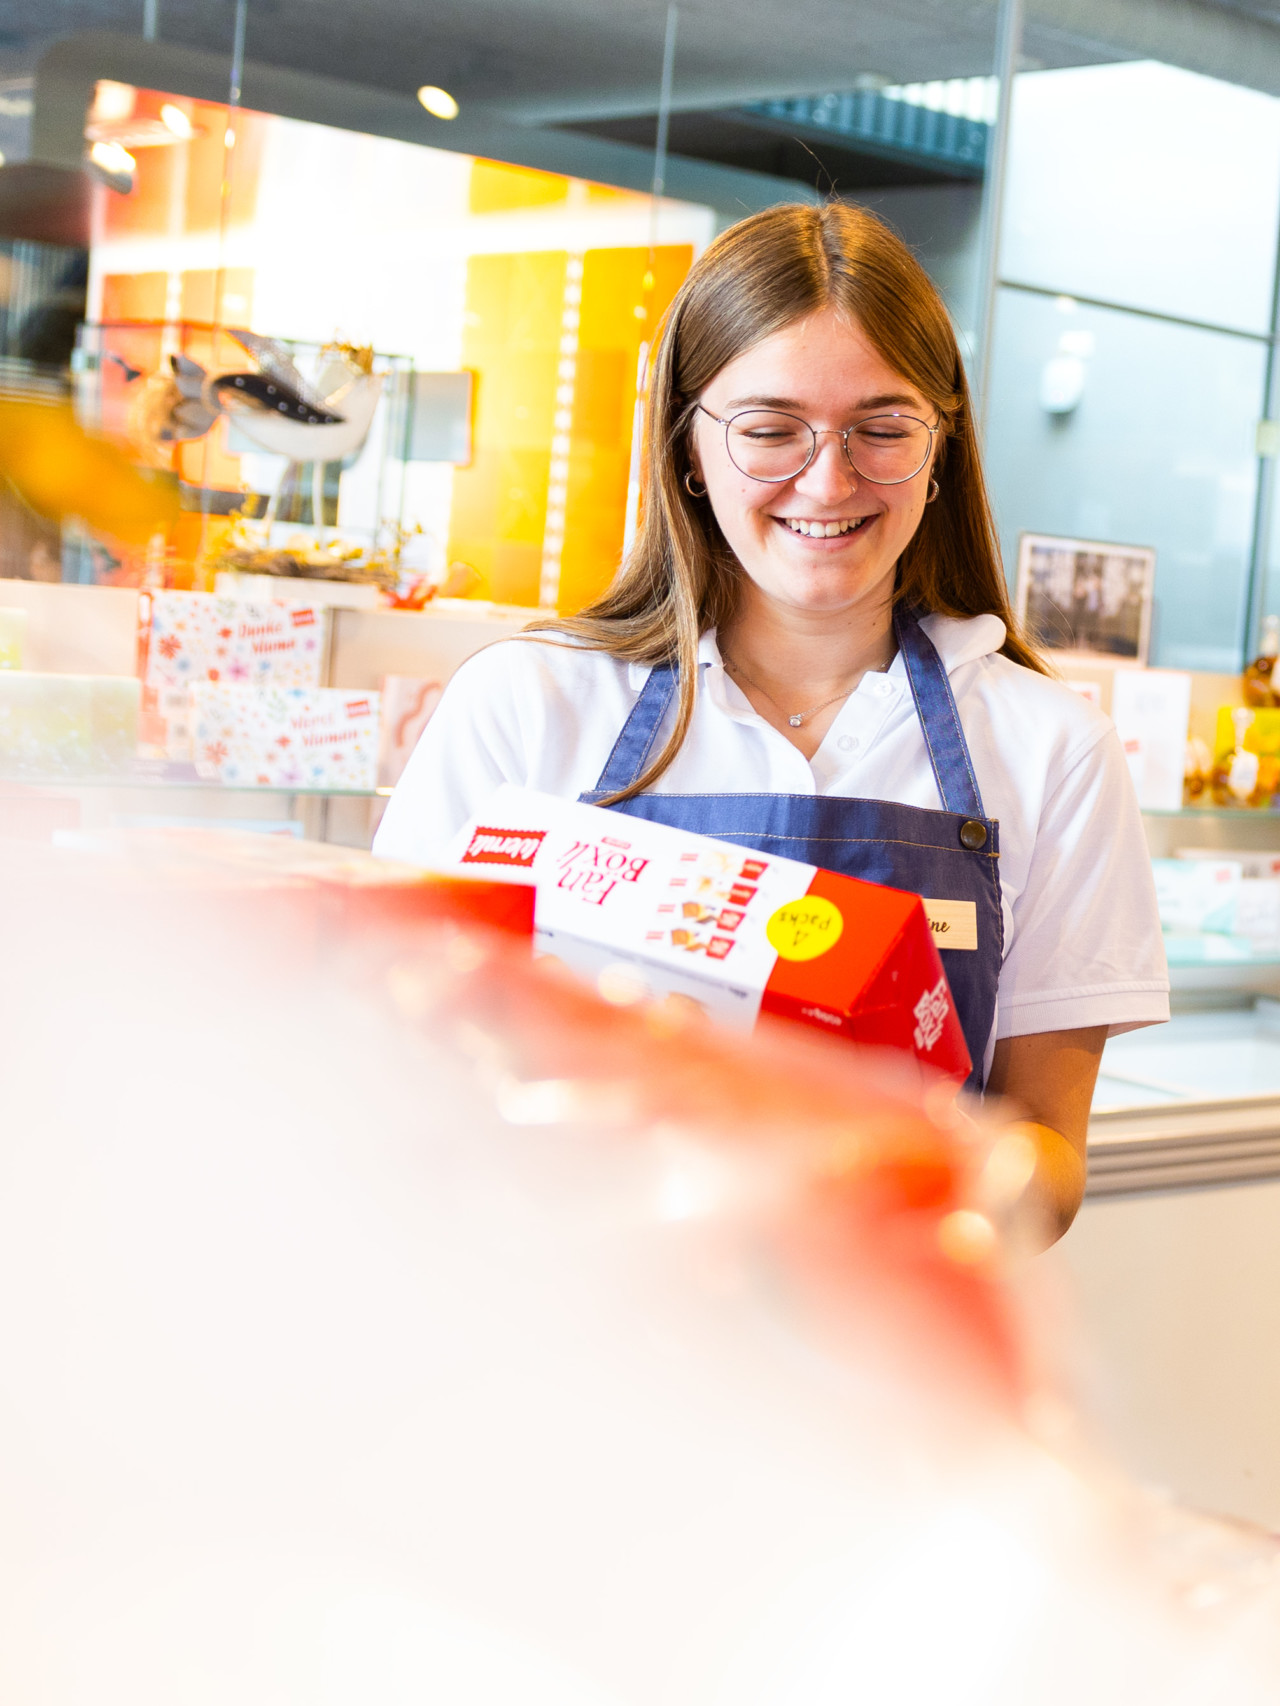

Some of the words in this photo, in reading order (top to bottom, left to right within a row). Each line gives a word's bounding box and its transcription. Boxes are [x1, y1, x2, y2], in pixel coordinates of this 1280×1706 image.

[556, 867, 618, 907] Fan
[779, 911, 833, 931] packs
[791, 929, 810, 948] 4
